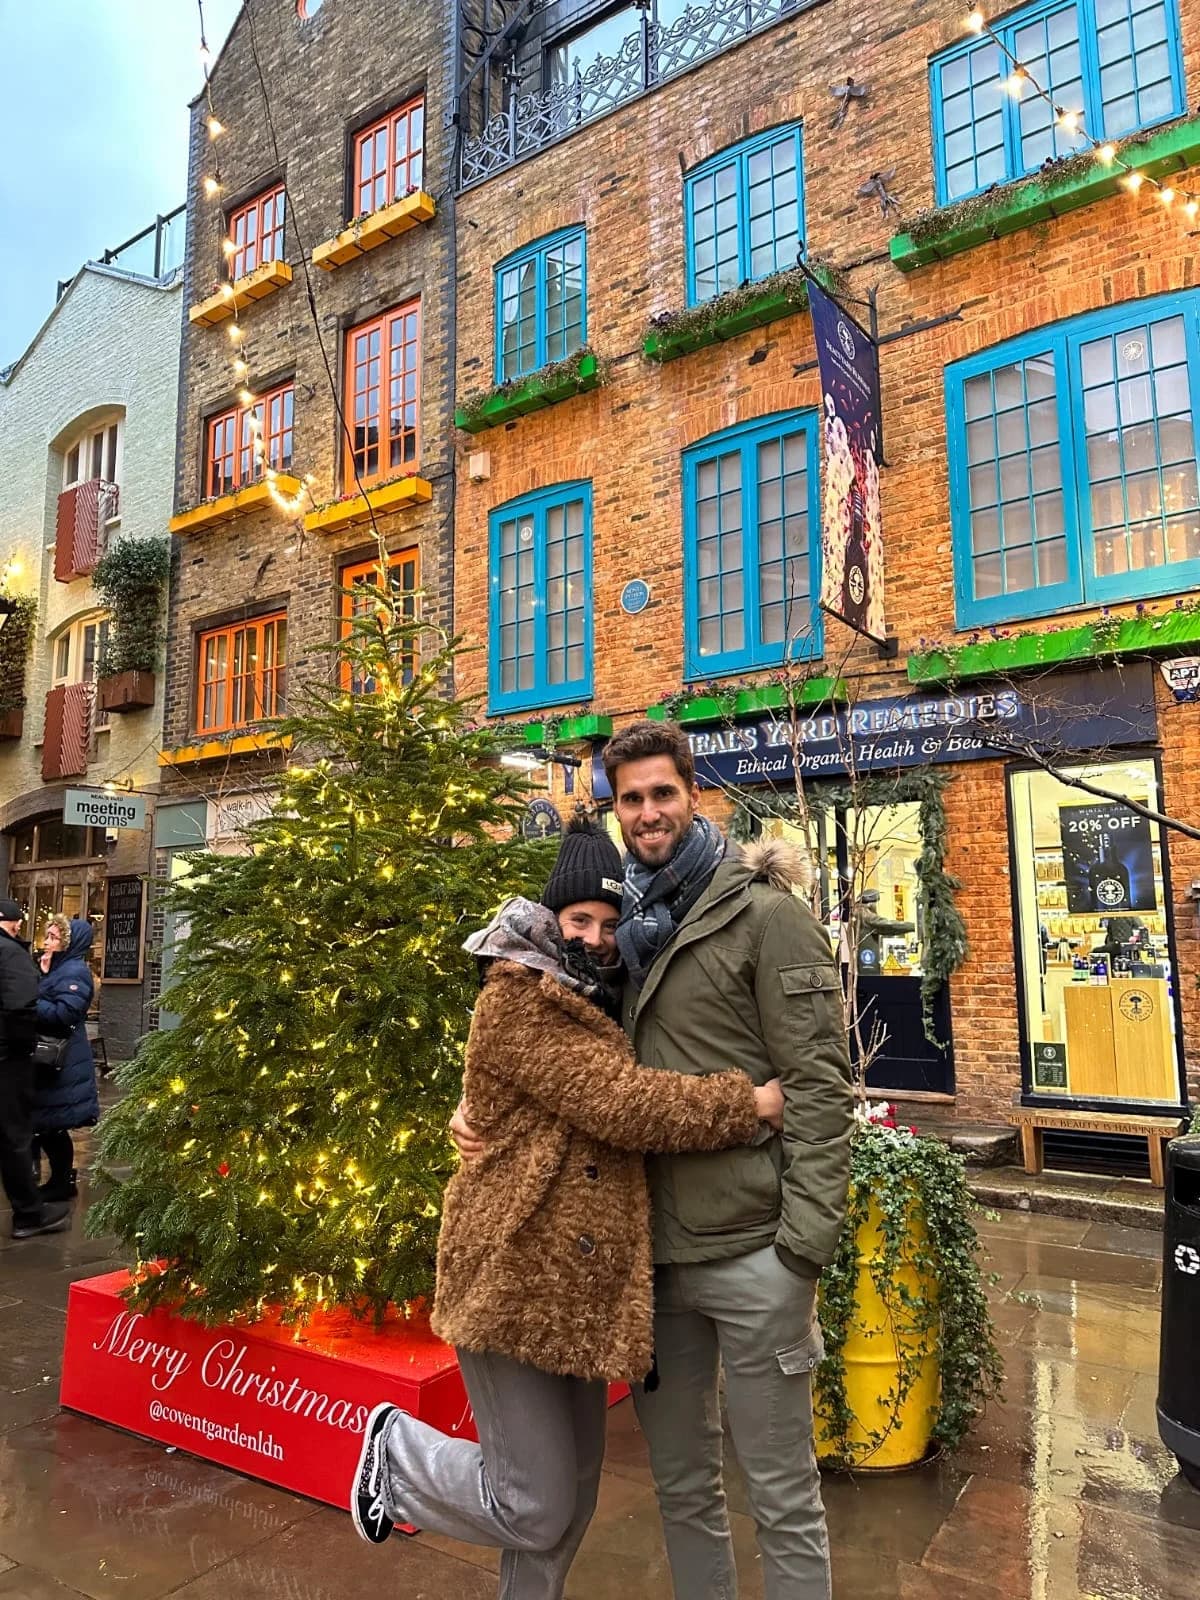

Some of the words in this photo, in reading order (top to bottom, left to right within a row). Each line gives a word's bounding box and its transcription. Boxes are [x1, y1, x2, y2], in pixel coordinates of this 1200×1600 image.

[761, 718, 840, 747] YARD
[849, 690, 1019, 735] REMEDIES
[735, 754, 787, 775] Ethical
[792, 747, 852, 769] Organic
[859, 740, 915, 761] Health
[921, 737, 942, 754] &
[76, 802, 136, 820] meeting
[226, 800, 252, 812] walk-in
[84, 814, 128, 827] rooms
[1068, 818, 1102, 833] 20%
[1107, 815, 1141, 830] OFF
[1011, 1116, 1048, 1126] HEALTH
[1060, 1119, 1099, 1130] BEAUTY
[1114, 1123, 1171, 1136] HAPPINESS
[92, 1310, 193, 1391] Merry
[201, 1339, 371, 1433] Christmas
[149, 1400, 285, 1461] @coventgardenldn
